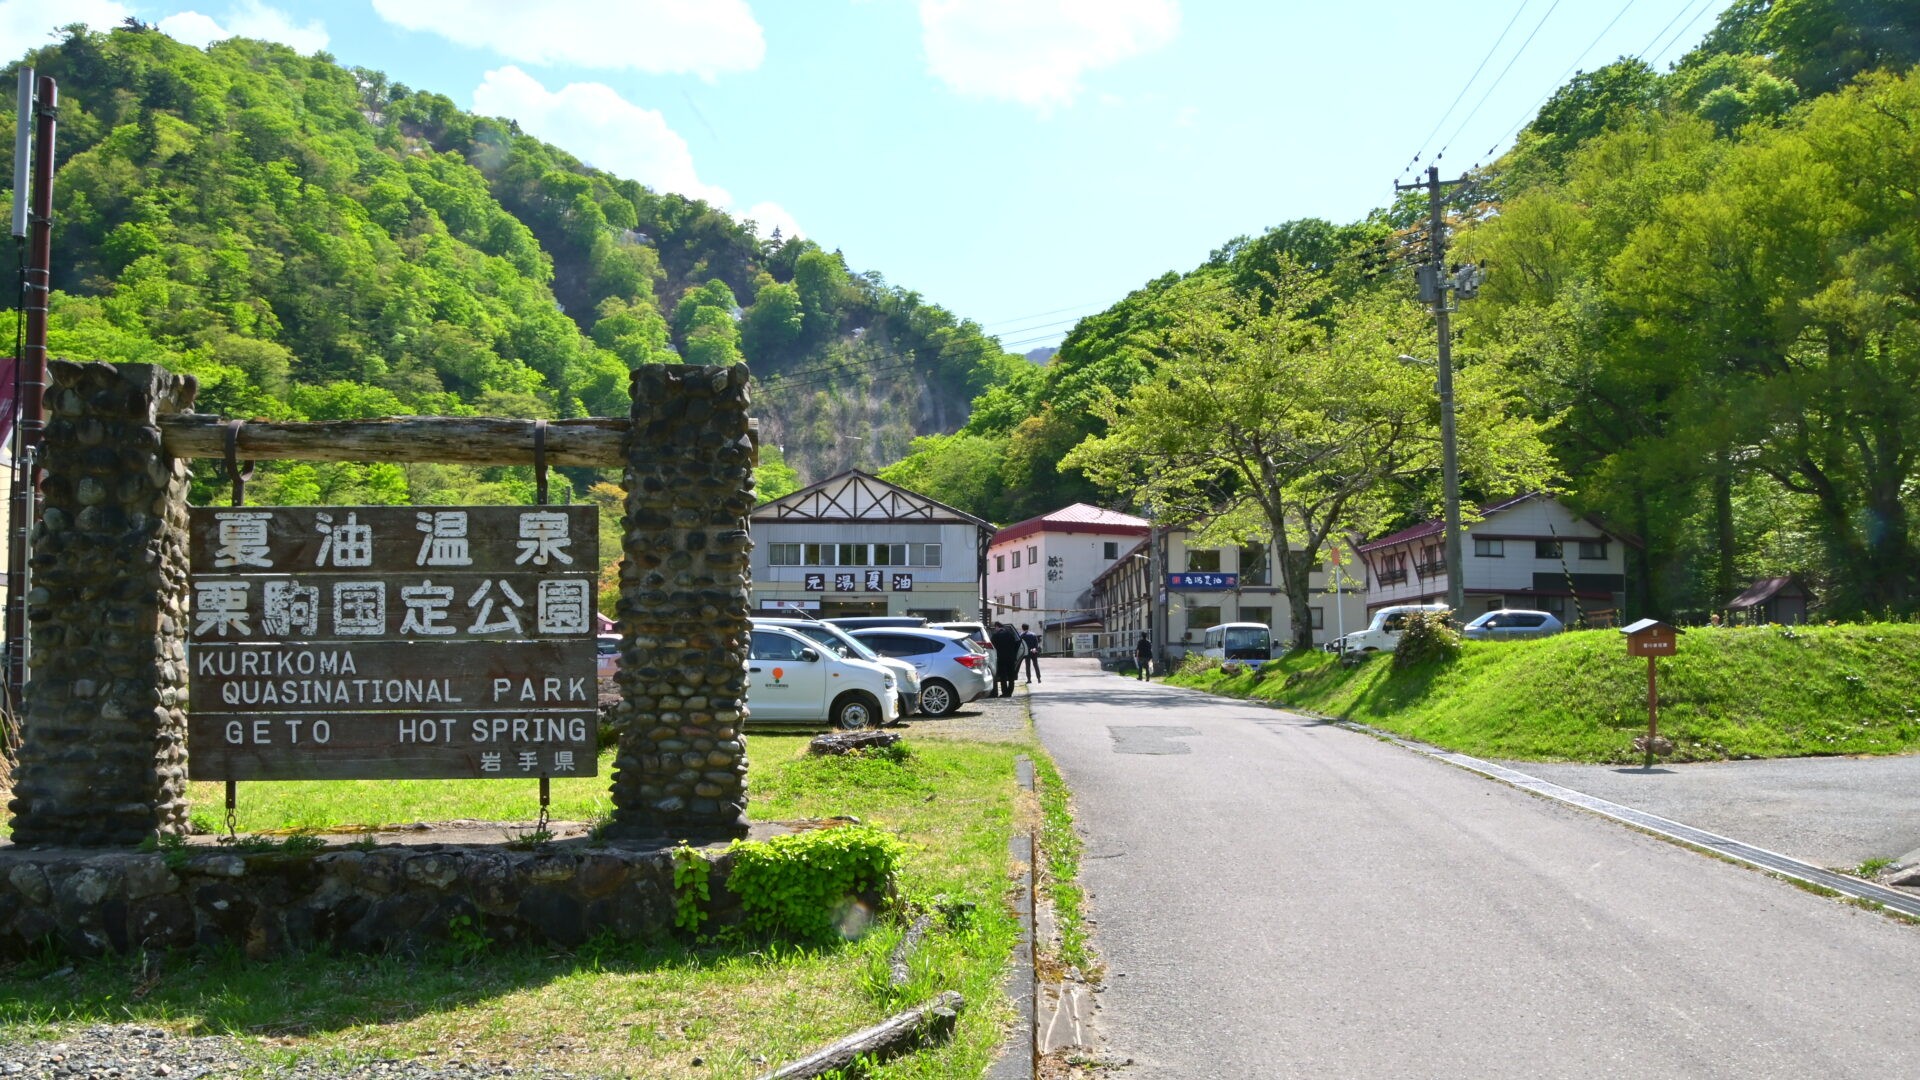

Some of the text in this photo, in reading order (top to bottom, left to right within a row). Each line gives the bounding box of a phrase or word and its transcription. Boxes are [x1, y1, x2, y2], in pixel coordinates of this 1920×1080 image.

[214, 511, 574, 568] 夏油温泉
[806, 570, 912, 592] 元湯夏油
[194, 579, 590, 636] 栗駒国定公園
[199, 650, 357, 676] KURIKOMA
[222, 677, 587, 705] QUASINATIONAL PARK
[398, 718, 457, 743] HOT
[471, 718, 587, 742] SPRING
[480, 751, 575, 772] 岩手県
